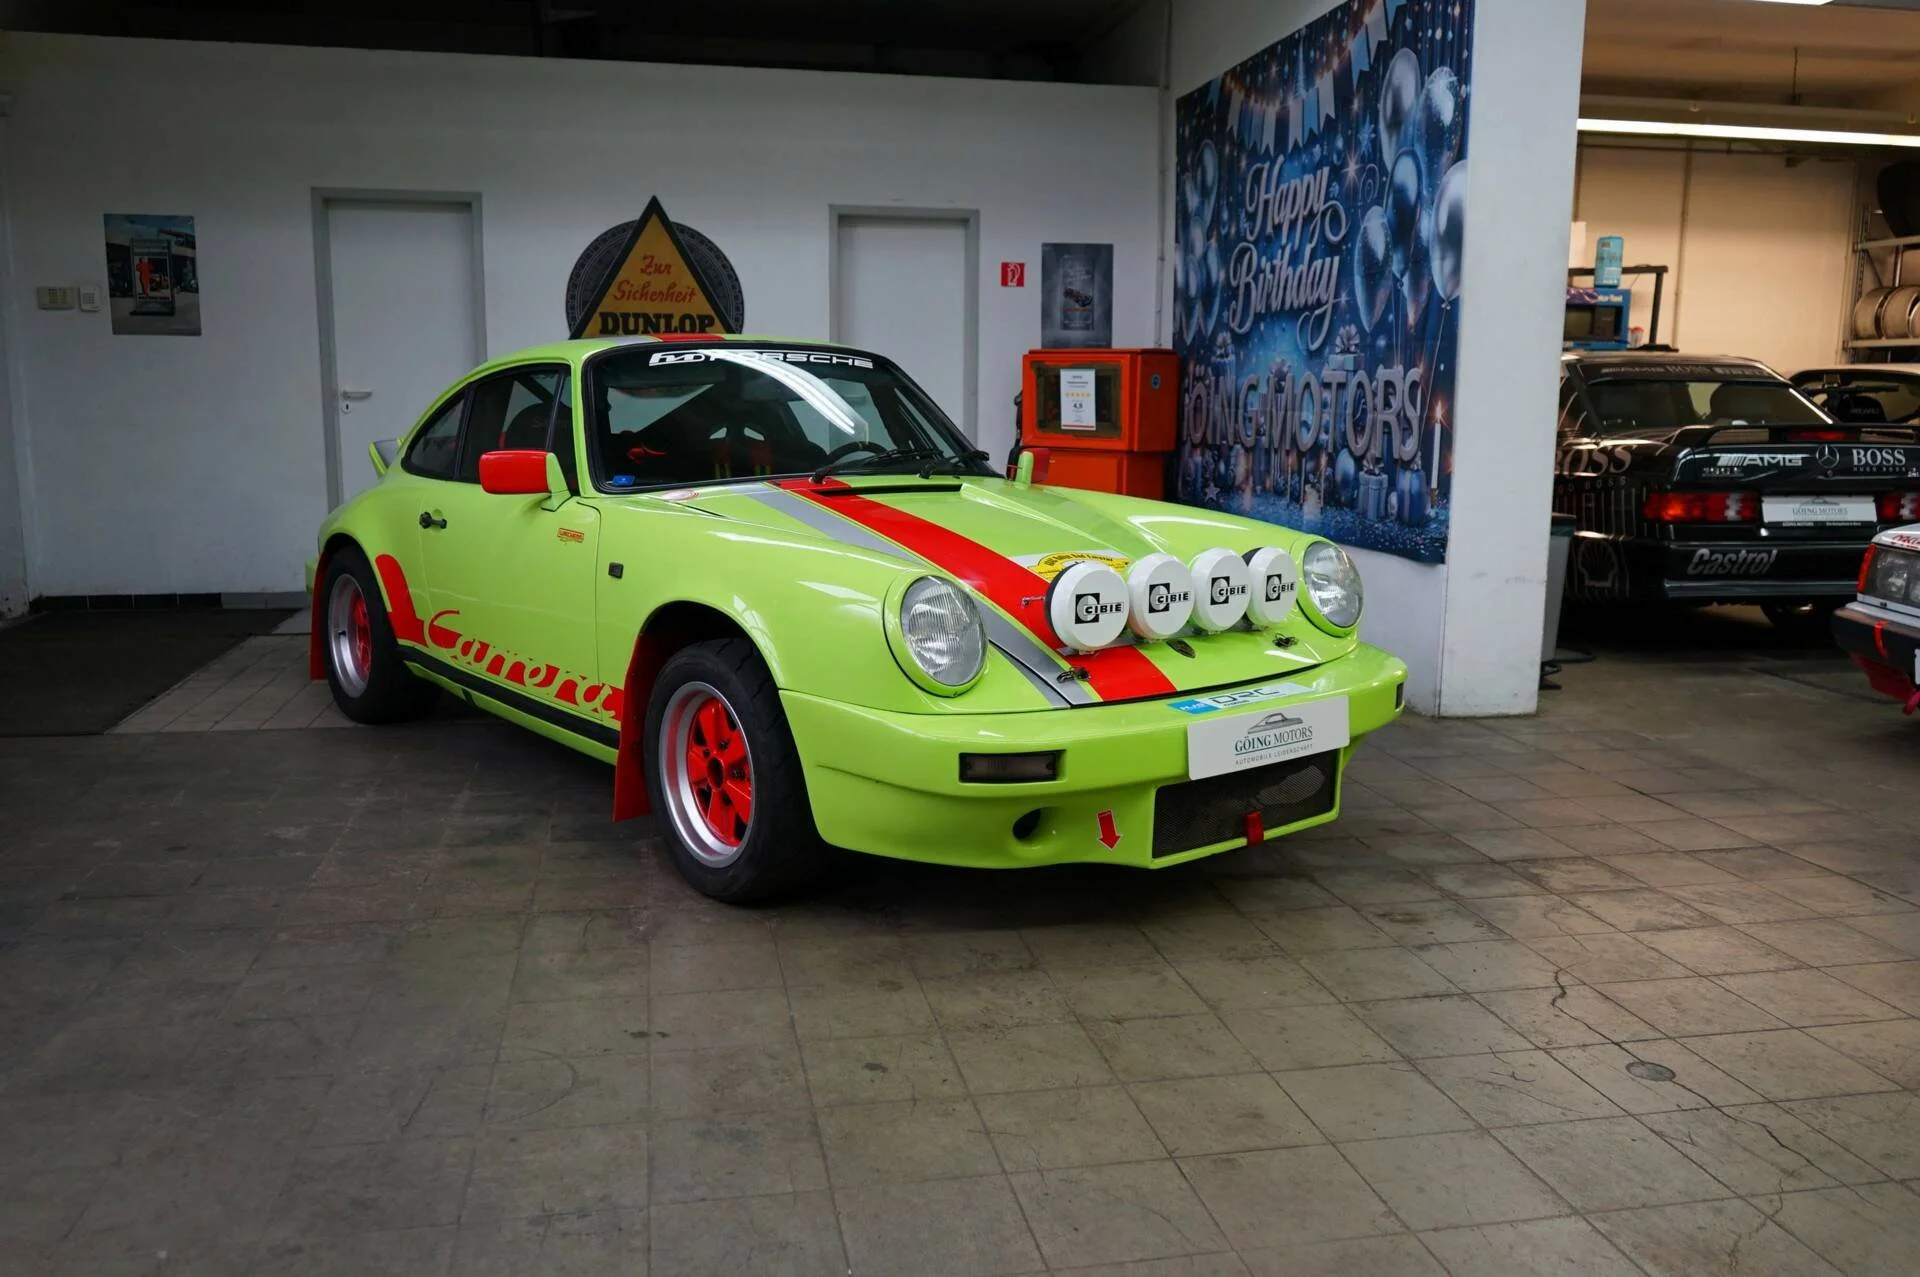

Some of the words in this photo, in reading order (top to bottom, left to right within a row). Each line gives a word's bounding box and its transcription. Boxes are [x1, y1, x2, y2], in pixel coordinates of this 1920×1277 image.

[1246, 155, 1346, 251] Happy
[640, 254, 672, 275] Zur
[613, 280, 697, 303] Sicherheit
[1229, 242, 1341, 351] Birthday
[598, 312, 716, 335] DUNLOP
[1267, 364, 1422, 461] MOTORS
[1743, 455, 1803, 467] AMG
[1852, 449, 1906, 466] BOSS
[1687, 548, 1778, 575] Castrol
[1234, 735, 1272, 753] GÖING
[1273, 726, 1313, 745] MOTORS
